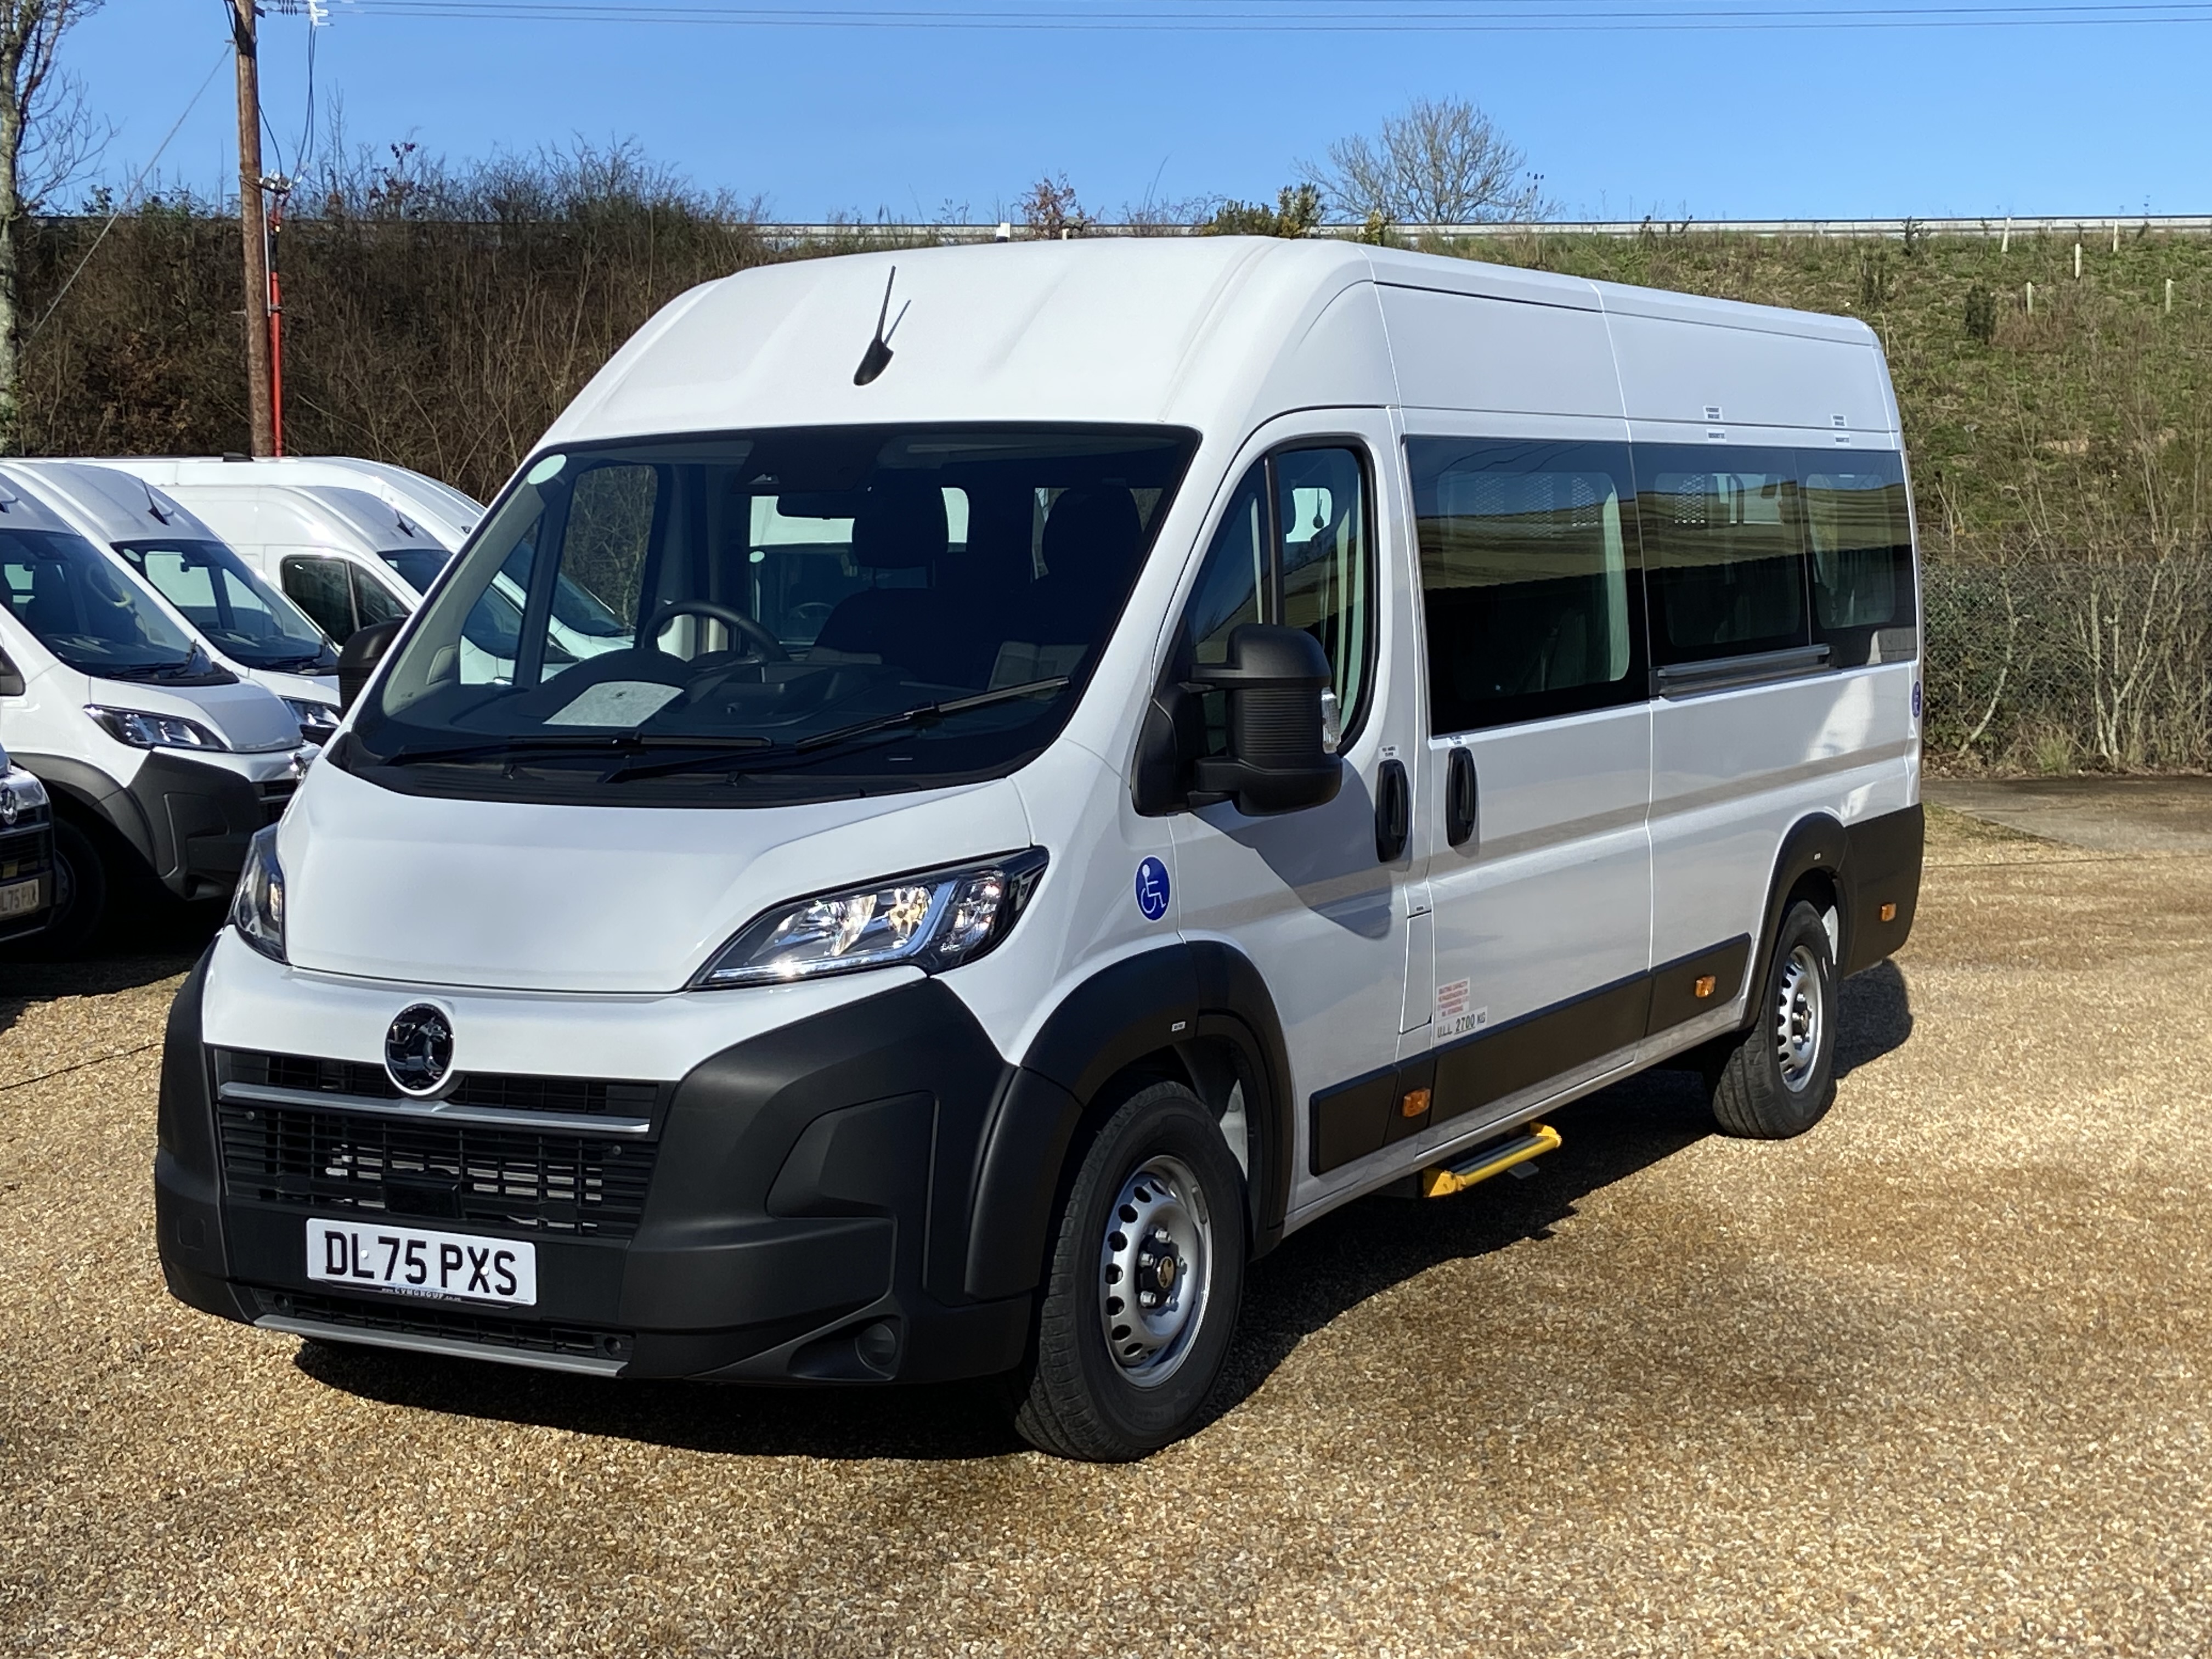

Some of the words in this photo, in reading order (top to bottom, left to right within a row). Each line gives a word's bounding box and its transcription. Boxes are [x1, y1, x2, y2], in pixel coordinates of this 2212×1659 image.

[1455, 1014, 1475, 1032] 2700
[325, 1231, 427, 1285] DL75
[440, 1243, 517, 1296] PXS
